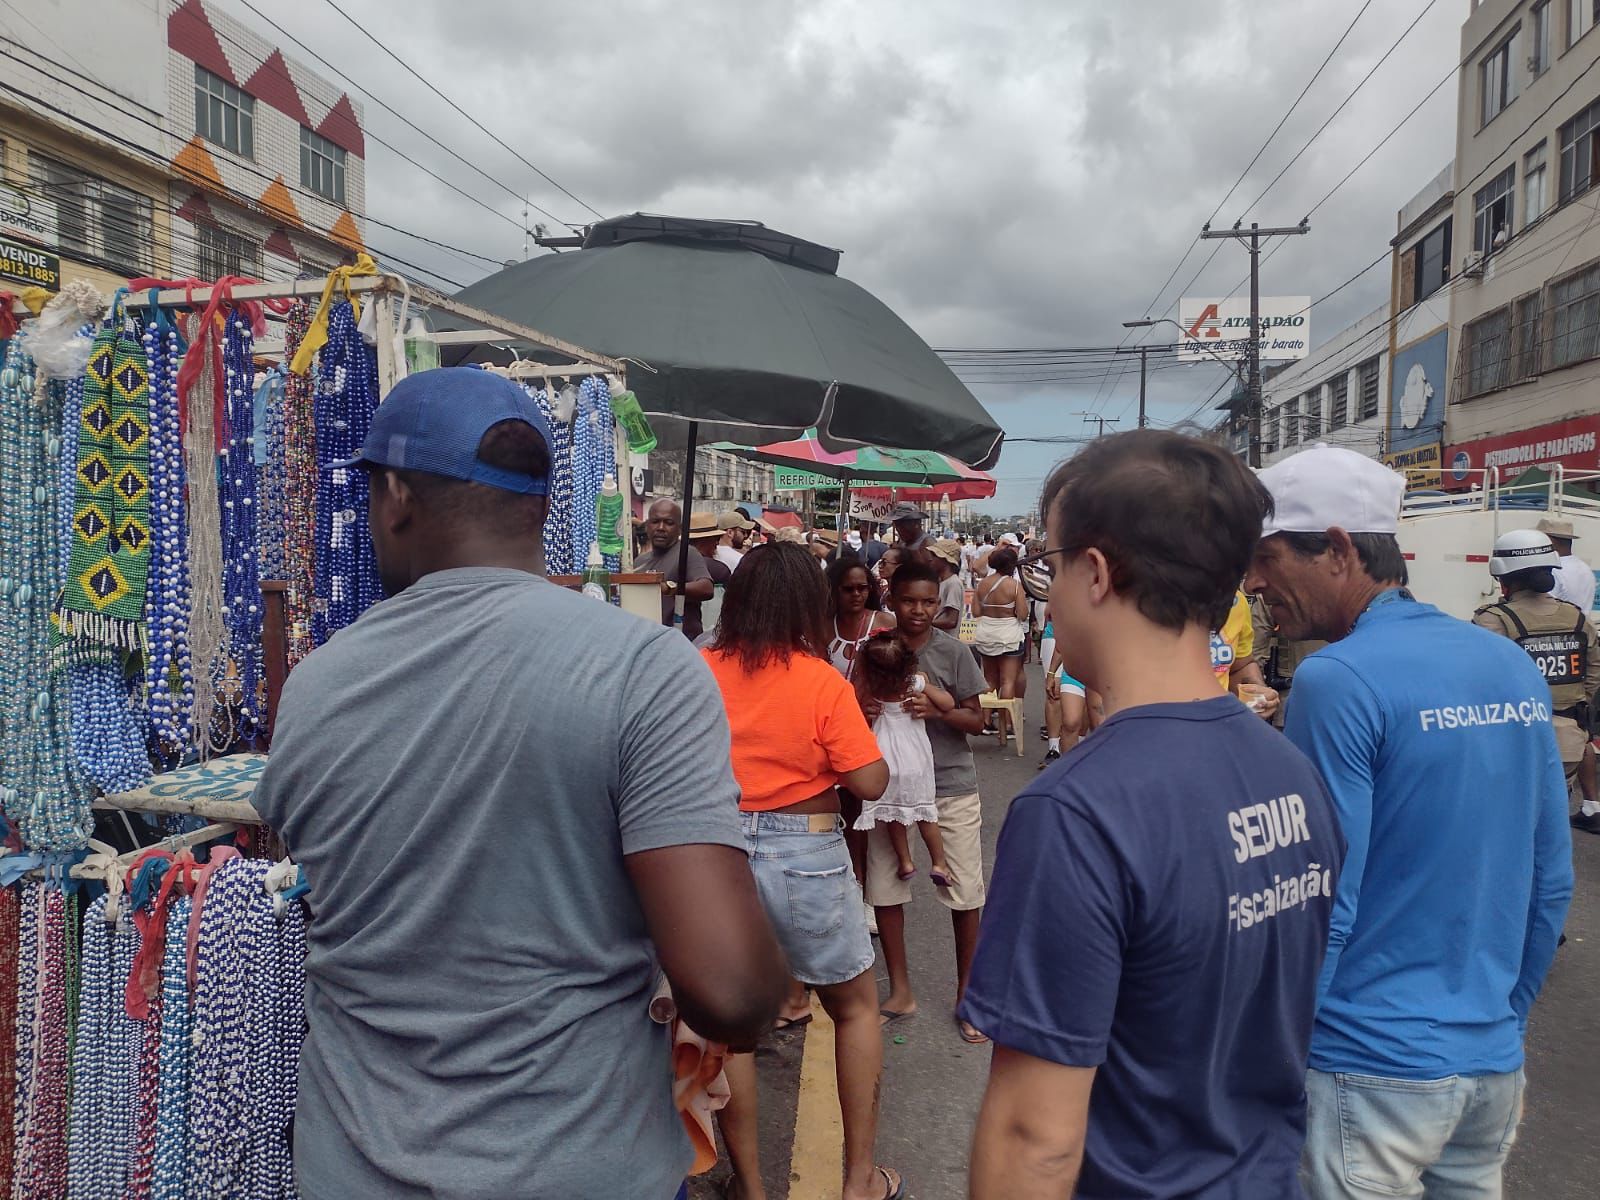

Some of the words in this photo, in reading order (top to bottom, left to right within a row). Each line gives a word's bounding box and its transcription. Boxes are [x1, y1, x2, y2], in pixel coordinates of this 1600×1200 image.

[0, 244, 47, 268] VENDE
[1223, 315, 1304, 328] ATAADÃO
[1213, 340, 1226, 350] de
[1228, 341, 1270, 353] compar
[1272, 339, 1304, 349] barato
[1535, 441, 1546, 460] DE
[1546, 432, 1596, 458] PARAFUSOS
[780, 475, 815, 486] REFRIG
[852, 500, 861, 514] 3
[861, 502, 873, 512] POR
[1511, 548, 1534, 556] POLÍCIA
[1524, 641, 1554, 652] POLÍCIA
[1554, 640, 1580, 651] MILITAR
[1536, 655, 1567, 678] 925
[1420, 697, 1549, 731] FISCALIZAÇÃO
[1227, 794, 1311, 864] SEDUR
